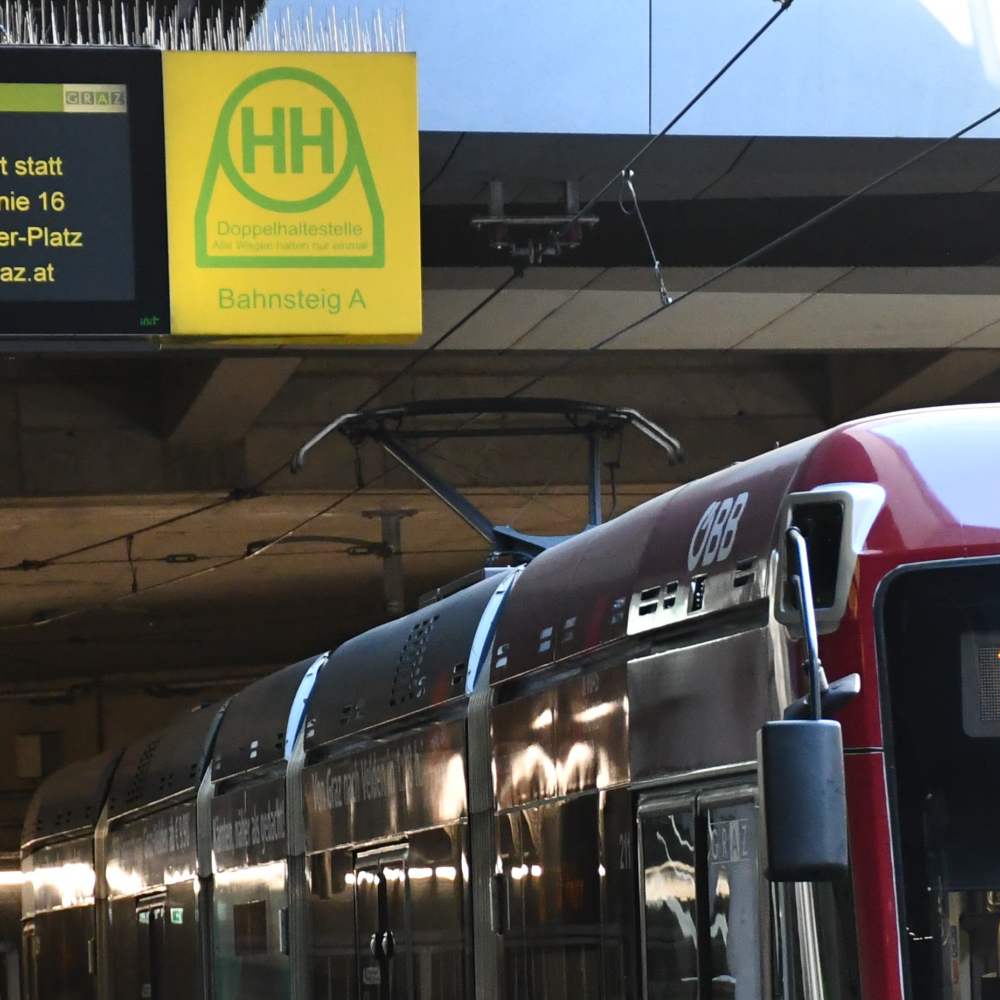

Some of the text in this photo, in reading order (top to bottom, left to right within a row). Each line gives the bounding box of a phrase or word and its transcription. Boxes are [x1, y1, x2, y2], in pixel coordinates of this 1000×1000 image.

[66, 91, 124, 105] GRAZ
[241, 107, 334, 175] HH
[14, 156, 63, 176] statt
[38, 191, 65, 212] 16
[0, 226, 83, 247] er-Platz
[217, 221, 363, 238] Doppelhaltestelle
[212, 240, 368, 252] Alle Wagen halten nur einmal
[0, 263, 55, 282] az.at
[218, 288, 367, 315] Bahnsteig A
